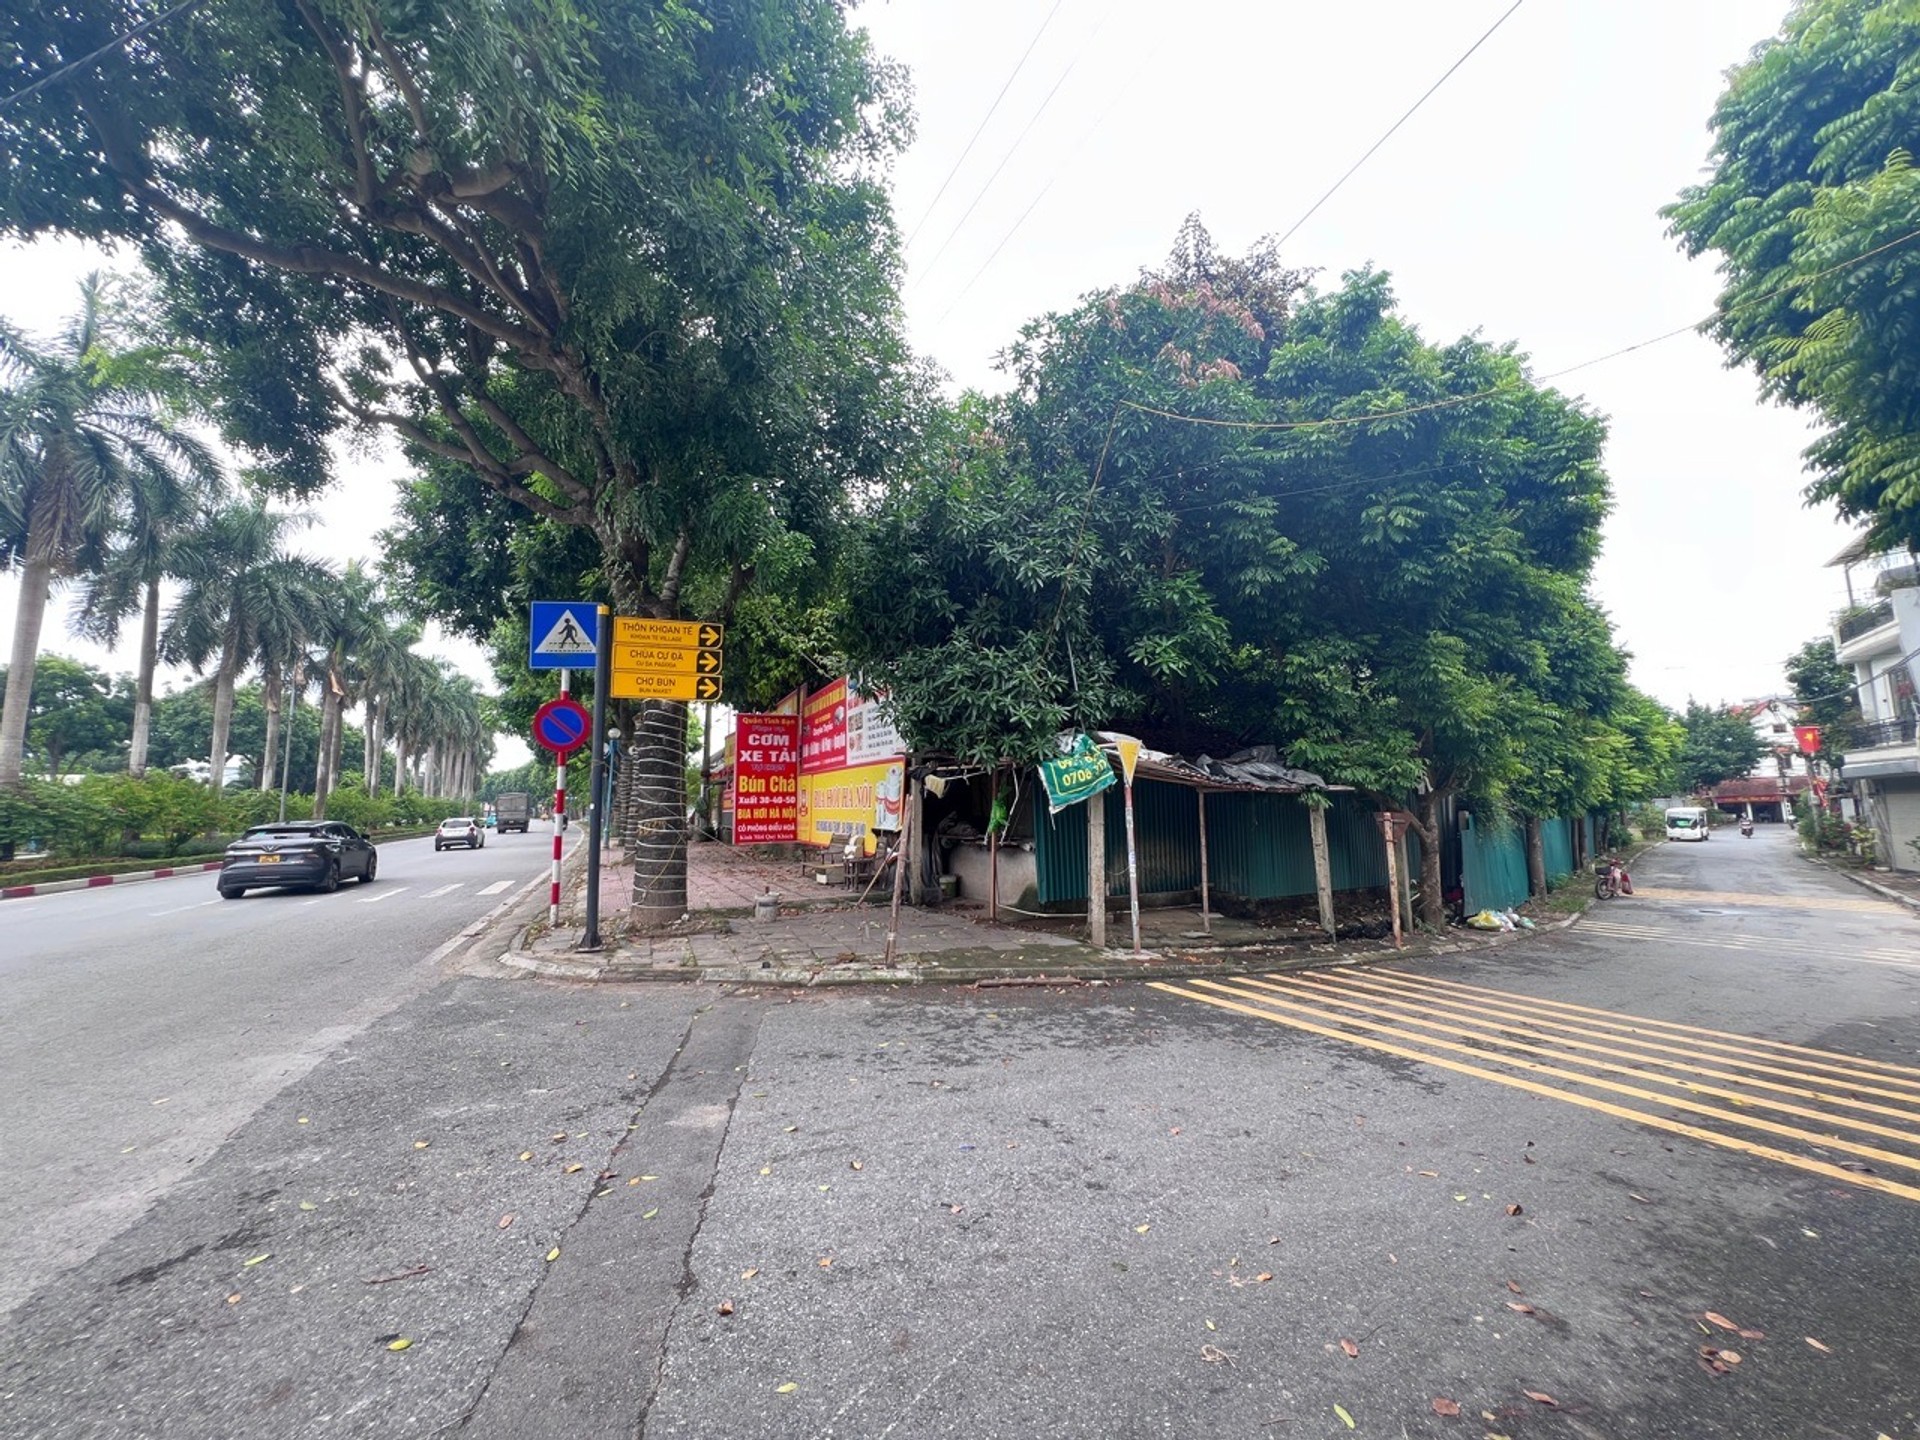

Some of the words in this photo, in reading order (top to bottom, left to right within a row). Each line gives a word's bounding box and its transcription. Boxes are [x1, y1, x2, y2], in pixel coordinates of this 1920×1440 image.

[649, 624, 681, 634] KHOAN
[748, 733, 790, 746] CƠM
[739, 750, 763, 762] XE
[768, 747, 797, 762] TẢI
[739, 774, 766, 793] Bún
[769, 773, 796, 793] Chả
[738, 795, 758, 805] Xuất
[814, 788, 825, 809] BIA
[855, 778, 873, 815] NỘI
[737, 808, 752, 819] BIA
[753, 806, 768, 819] HƠI
[769, 805, 781, 819] HÀ
[782, 806, 797, 820] NỘI
